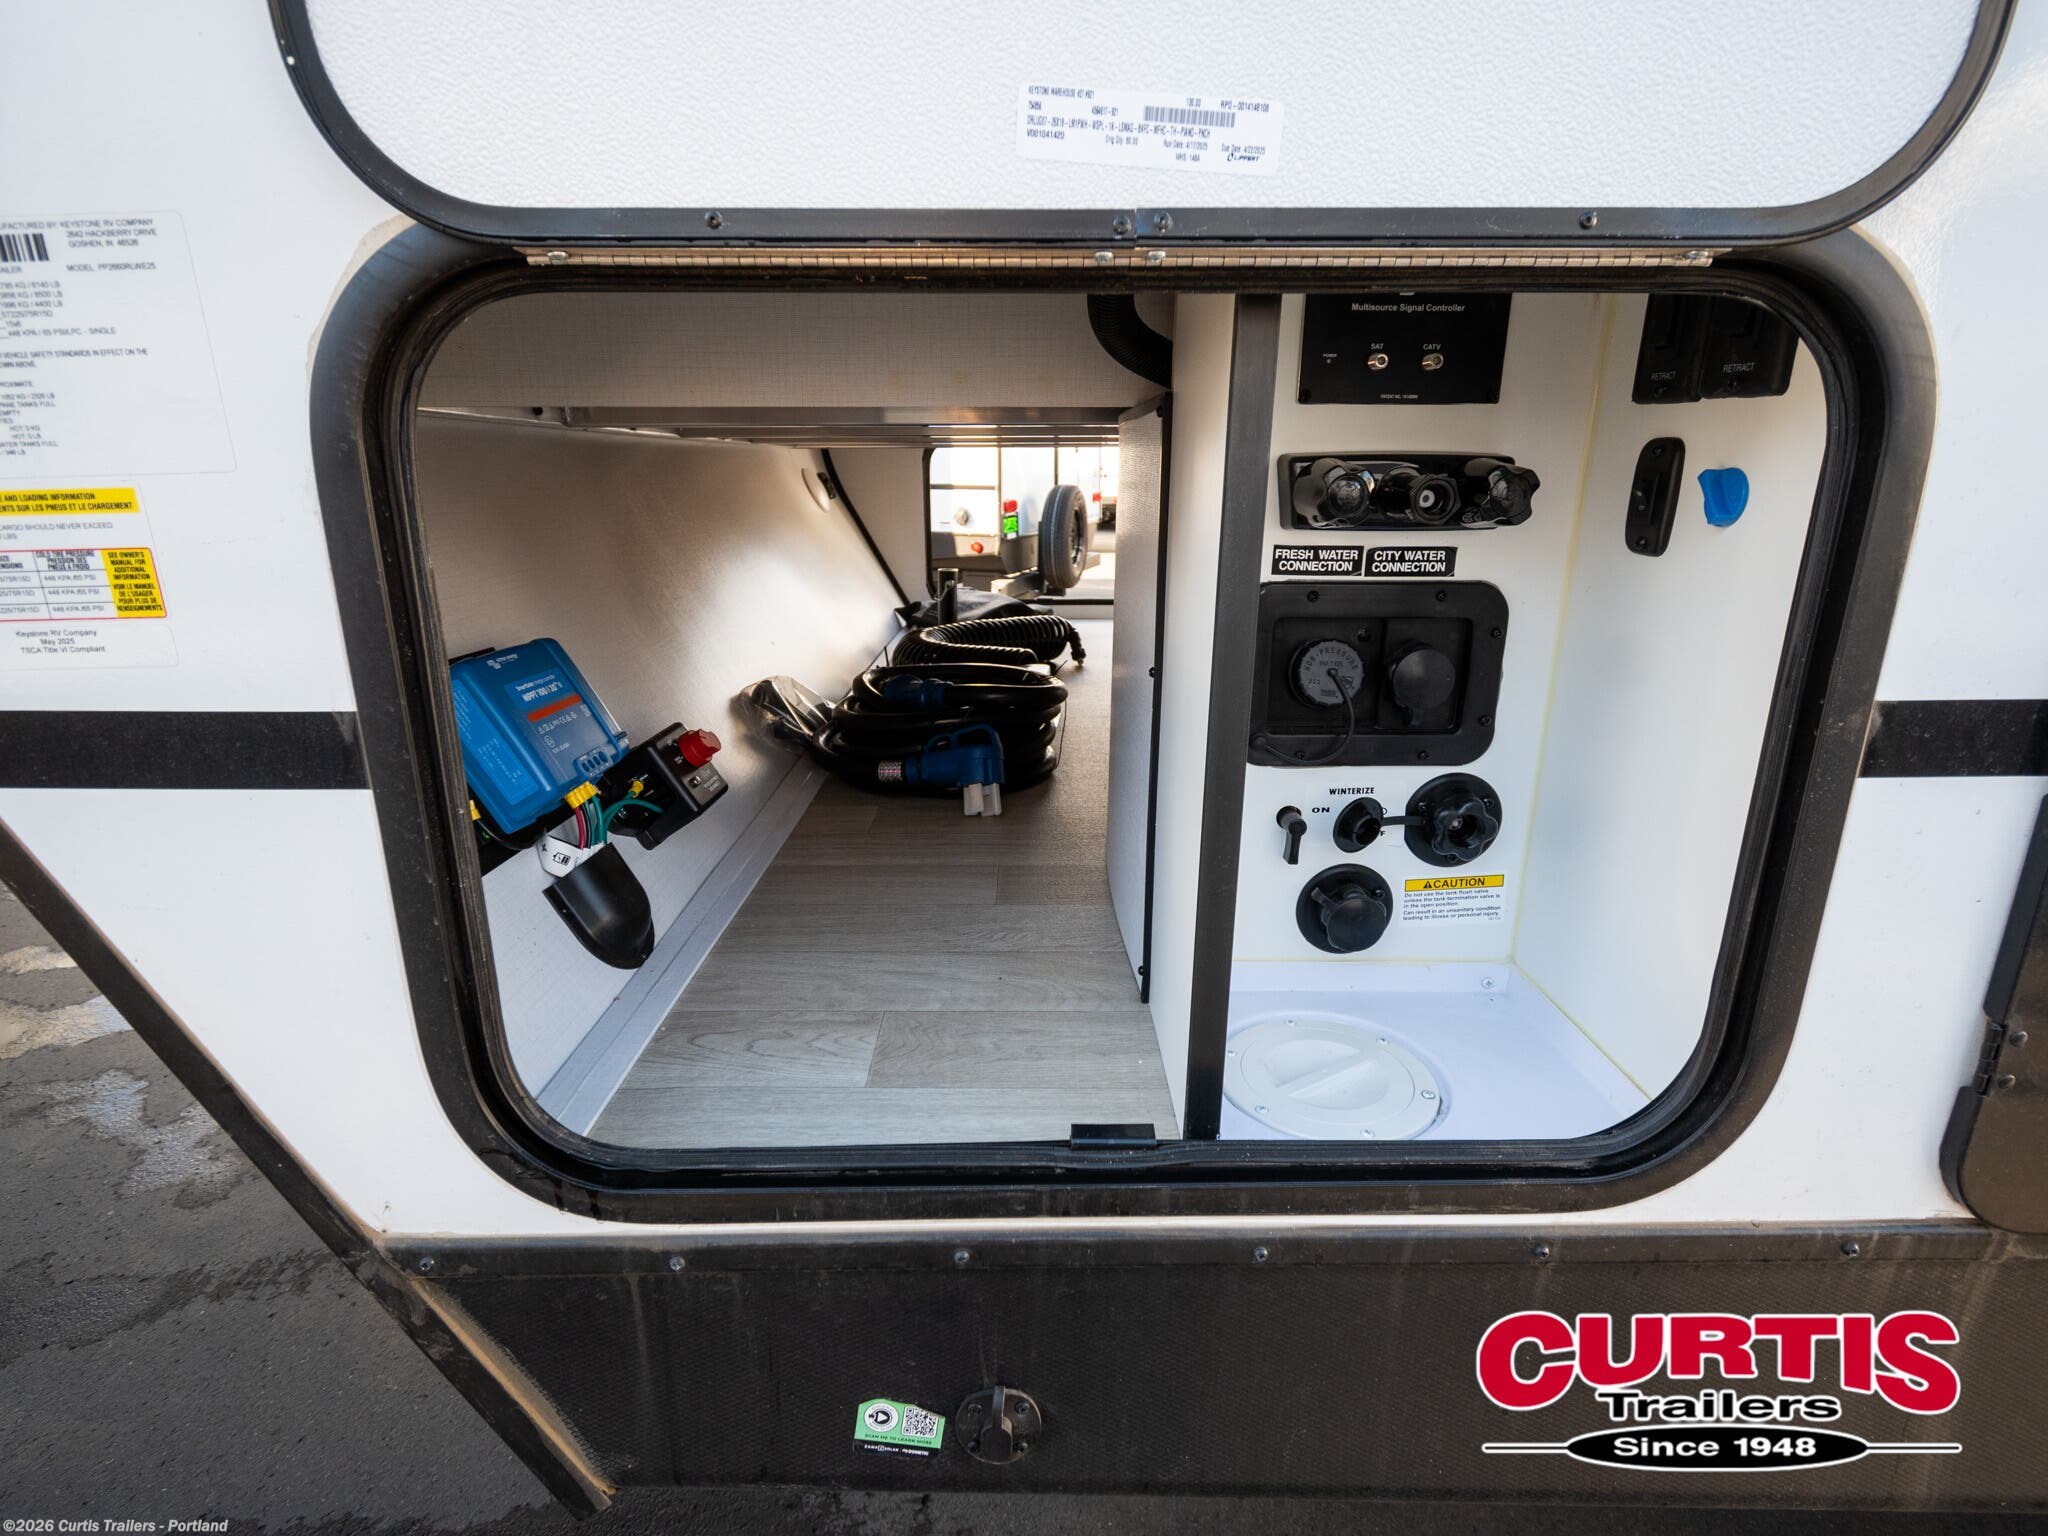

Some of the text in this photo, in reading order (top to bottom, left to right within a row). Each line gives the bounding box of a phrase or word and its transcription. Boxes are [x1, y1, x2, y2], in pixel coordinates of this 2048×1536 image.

[60, 220, 100, 228] KEYSTONE
[115, 218, 154, 226] COMPANY
[86, 229, 132, 238] HACKBERRY
[134, 228, 158, 236] DRIVE
[1352, 303, 1466, 313] Multisource Signal Controller
[1722, 362, 1755, 374] RETRACT
[20, 493, 48, 501] LOADING
[50, 492, 96, 500] INFORMATION
[16, 504, 30, 512] SUR
[32, 503, 44, 512] LES
[46, 502, 68, 511] PNEUS
[68, 502, 76, 510] ET
[78, 502, 86, 510] LE
[88, 501, 133, 510] CHARGEMENT
[1275, 550, 1358, 560] FRESH WATER
[1374, 550, 1446, 561] CITY WATER
[1278, 561, 1352, 571] CONNECTION
[1372, 562, 1446, 572] CONNECTION
[63, 629, 96, 637] Company
[70, 646, 106, 654] Compliant
[1329, 787, 1375, 795] WINTERIZE
[1433, 878, 1486, 889] CAUTION
